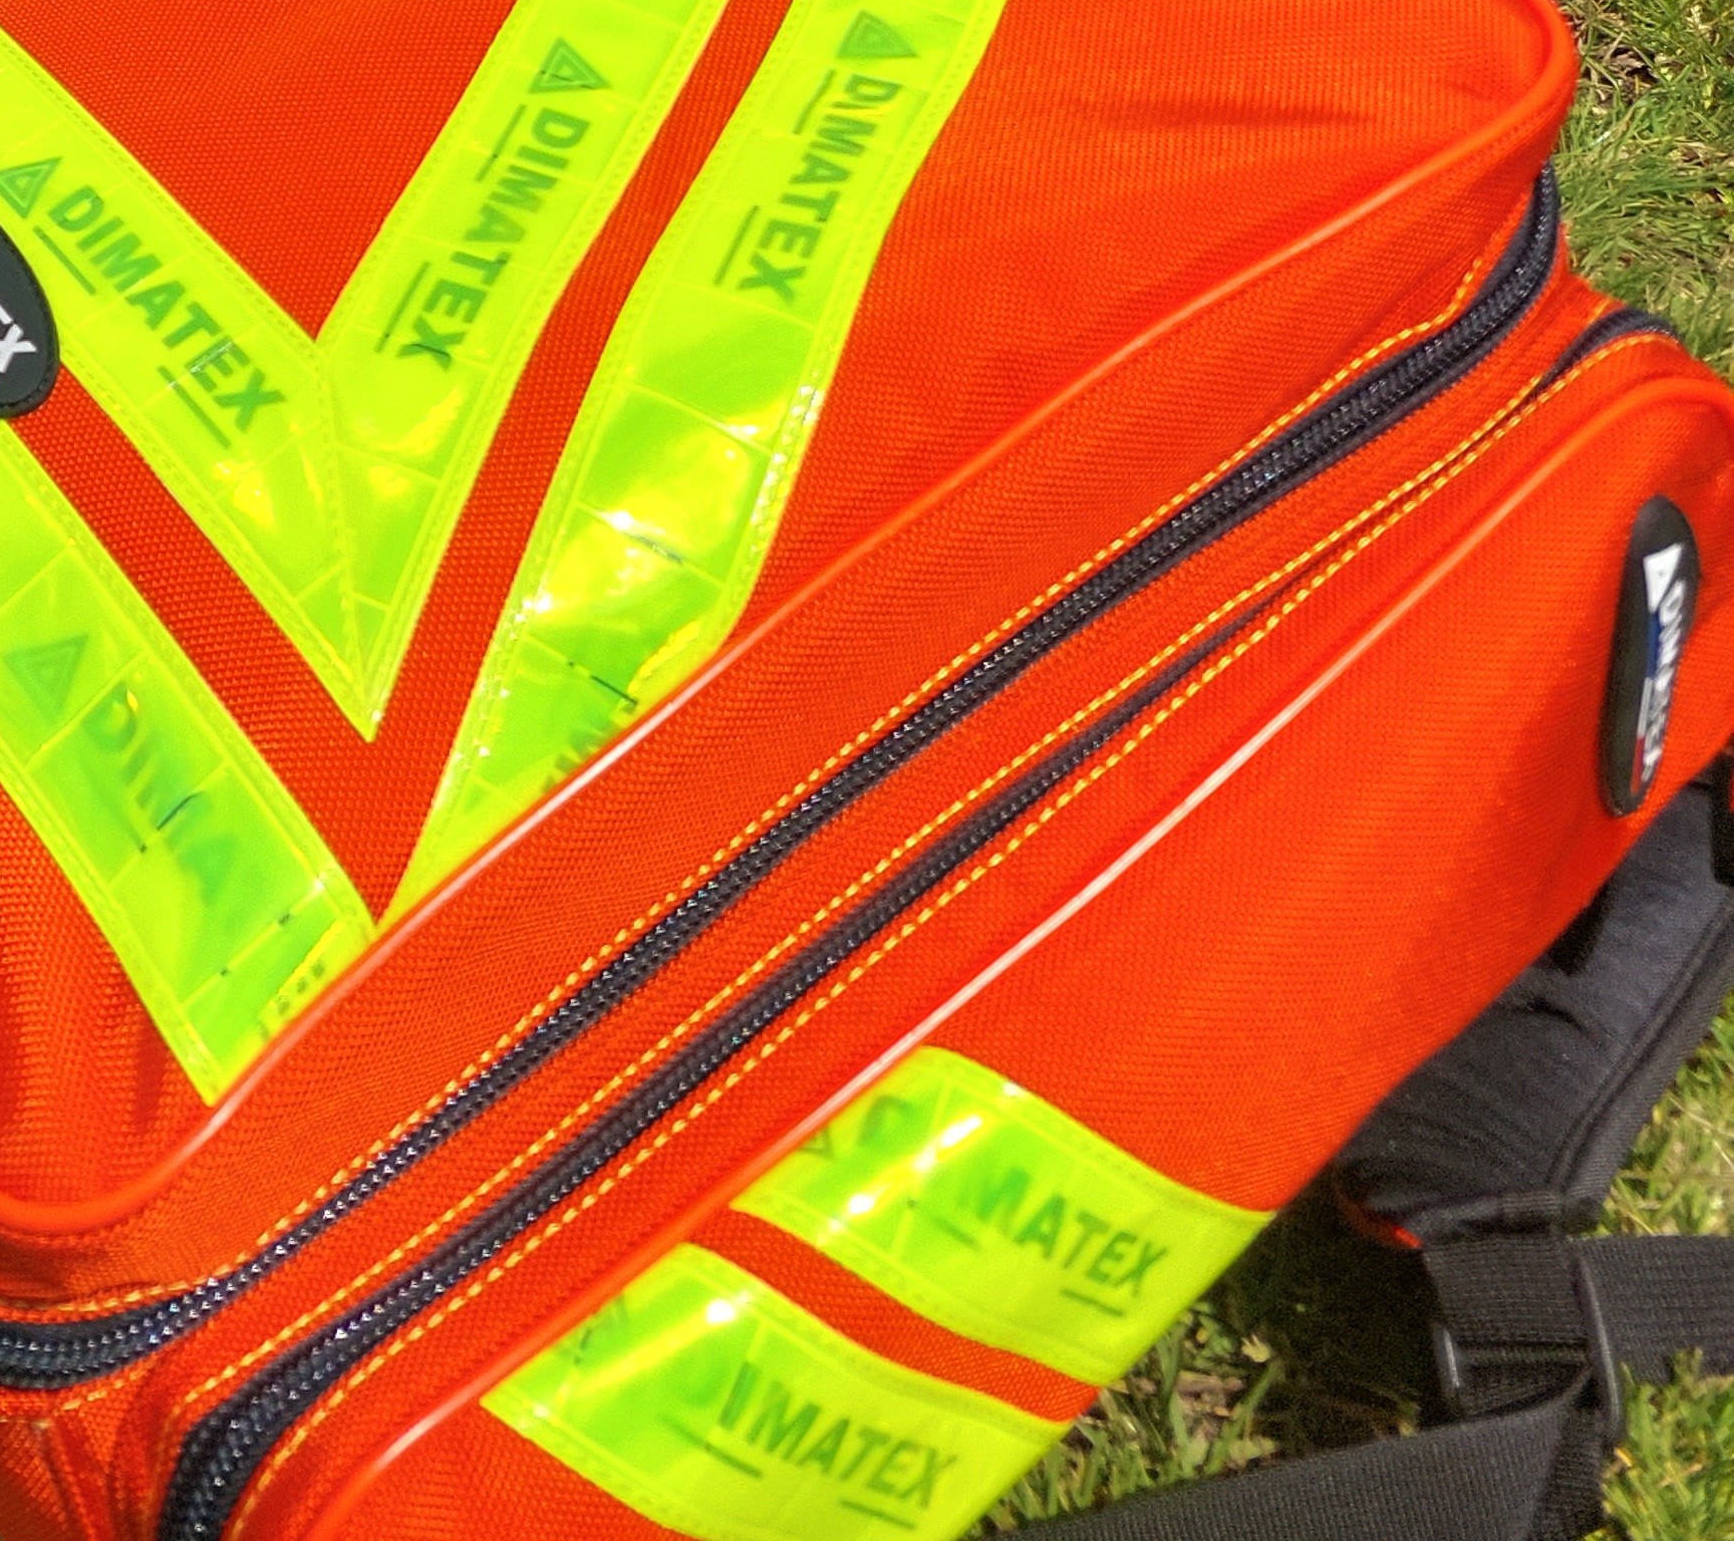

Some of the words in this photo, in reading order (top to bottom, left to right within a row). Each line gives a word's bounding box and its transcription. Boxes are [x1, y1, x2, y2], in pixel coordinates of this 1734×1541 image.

[49, 185, 283, 436] DIMATEX
[397, 106, 592, 373] DIMATEX
[738, 72, 902, 303] DIMATEX
